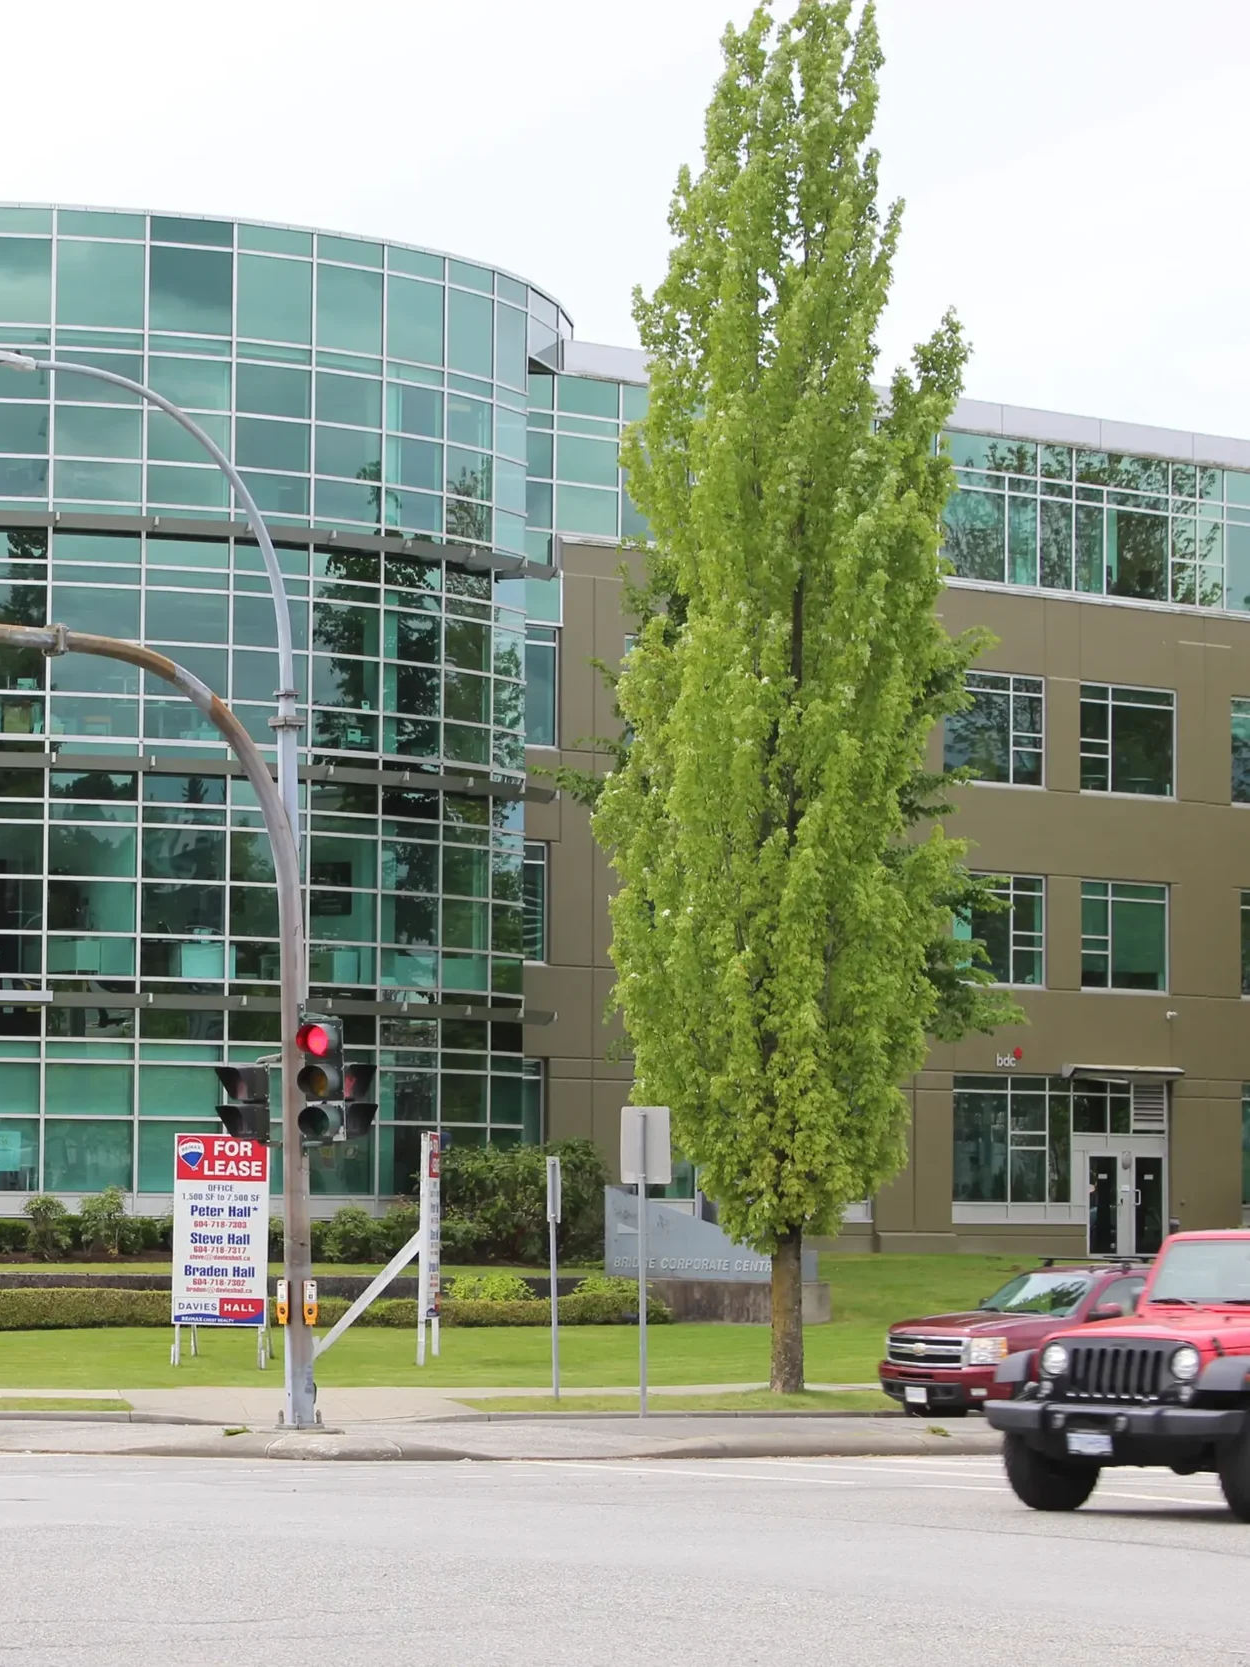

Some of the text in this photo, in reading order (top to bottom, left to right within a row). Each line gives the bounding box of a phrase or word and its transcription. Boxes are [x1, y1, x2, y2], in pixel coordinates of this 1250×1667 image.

[996, 1052, 1016, 1067] bdc
[213, 1140, 253, 1157] FOR
[203, 1160, 263, 1177] LEASE
[207, 1184, 234, 1192] OFFICE
[182, 1192, 261, 1202] 1,500 SF to 7,500 SF
[190, 1204, 224, 1217] Peter
[193, 1220, 248, 1229] 604-718-7303
[190, 1232, 251, 1245] Steve Hall
[193, 1245, 247, 1254] 604-718-7317
[613, 1256, 773, 1272] BRIDE CORPORATE CENTR
[184, 1264, 255, 1278] Braden Hall
[192, 1278, 247, 1287] 604-718-7302
[178, 1302, 255, 1312] DAVIES HALL
